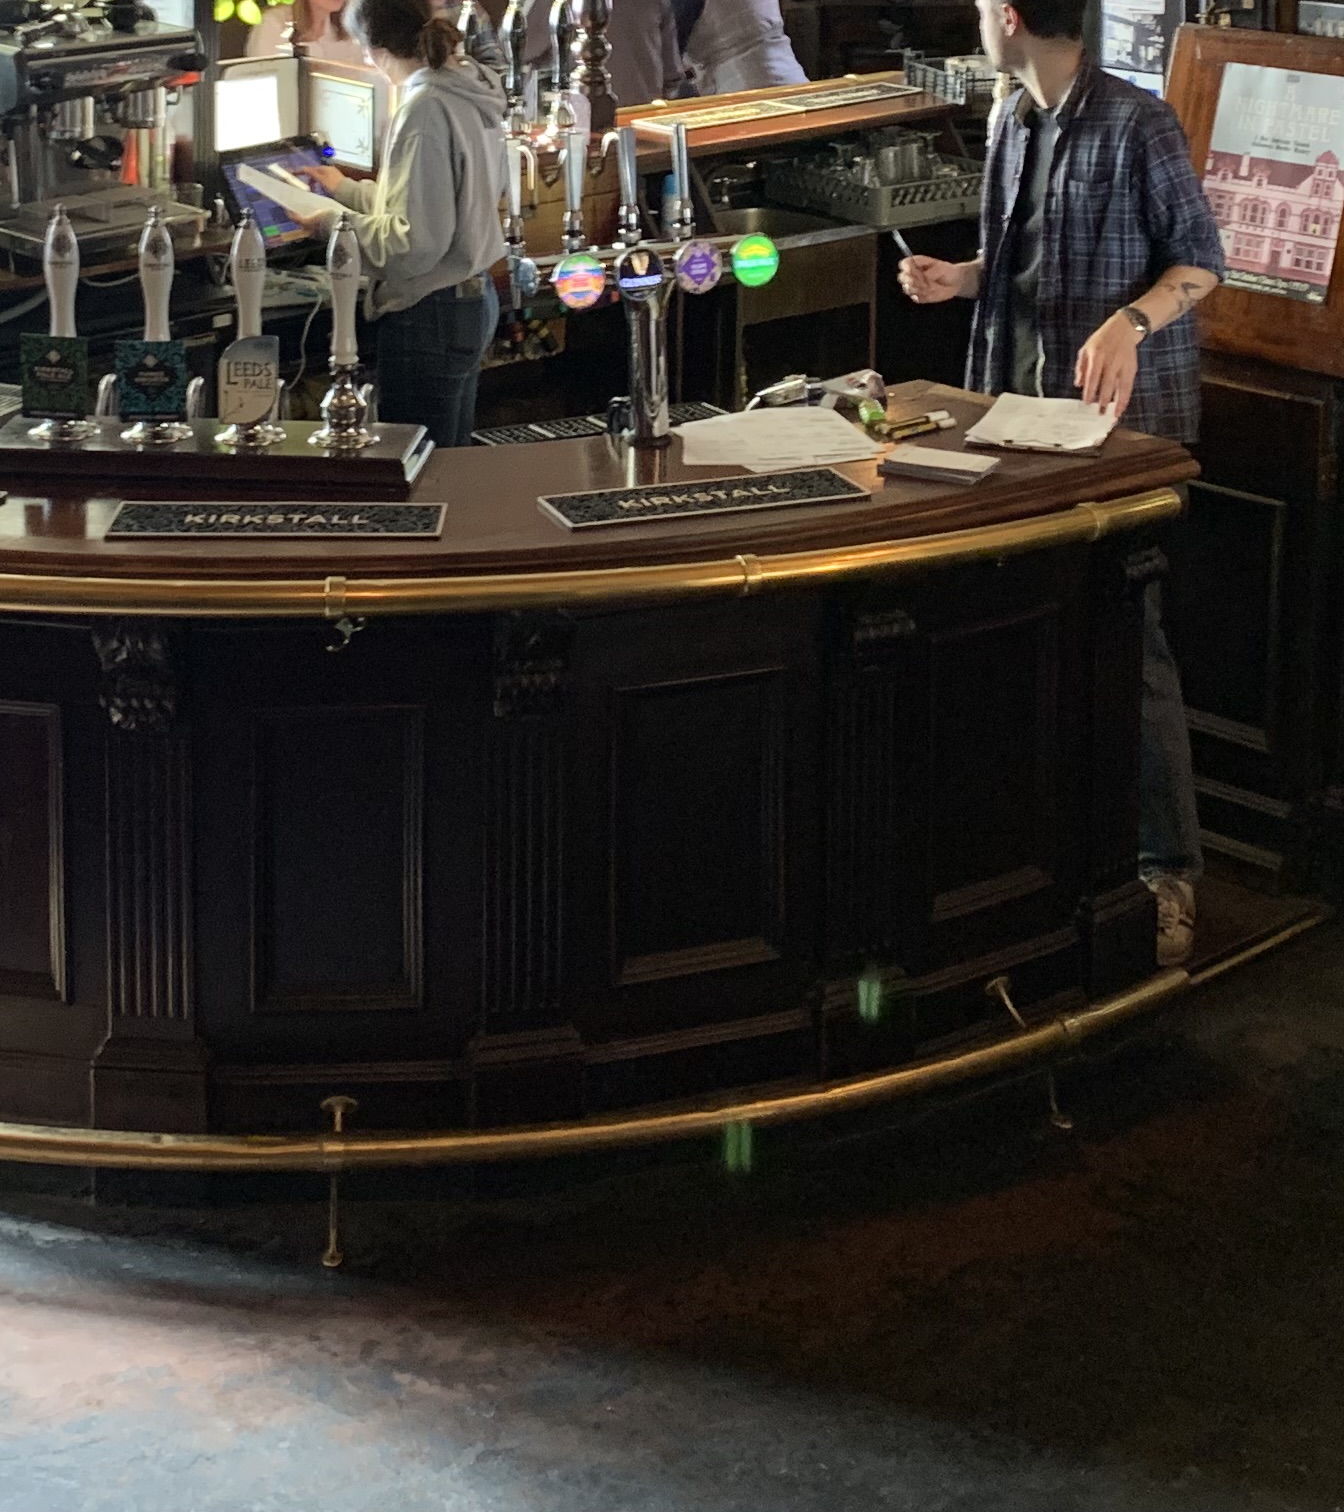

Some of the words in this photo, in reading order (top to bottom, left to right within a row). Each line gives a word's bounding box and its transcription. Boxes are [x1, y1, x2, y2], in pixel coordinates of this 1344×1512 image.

[1235, 96, 1341, 125] NIGHTMARE
[1237, 114, 1258, 131] IN
[1264, 117, 1330, 142] PASTEL
[225, 360, 273, 386] LEEDS
[243, 377, 273, 390] PALE
[617, 483, 792, 510] KIRKSTALL
[184, 512, 370, 525] KIRKSTALL
